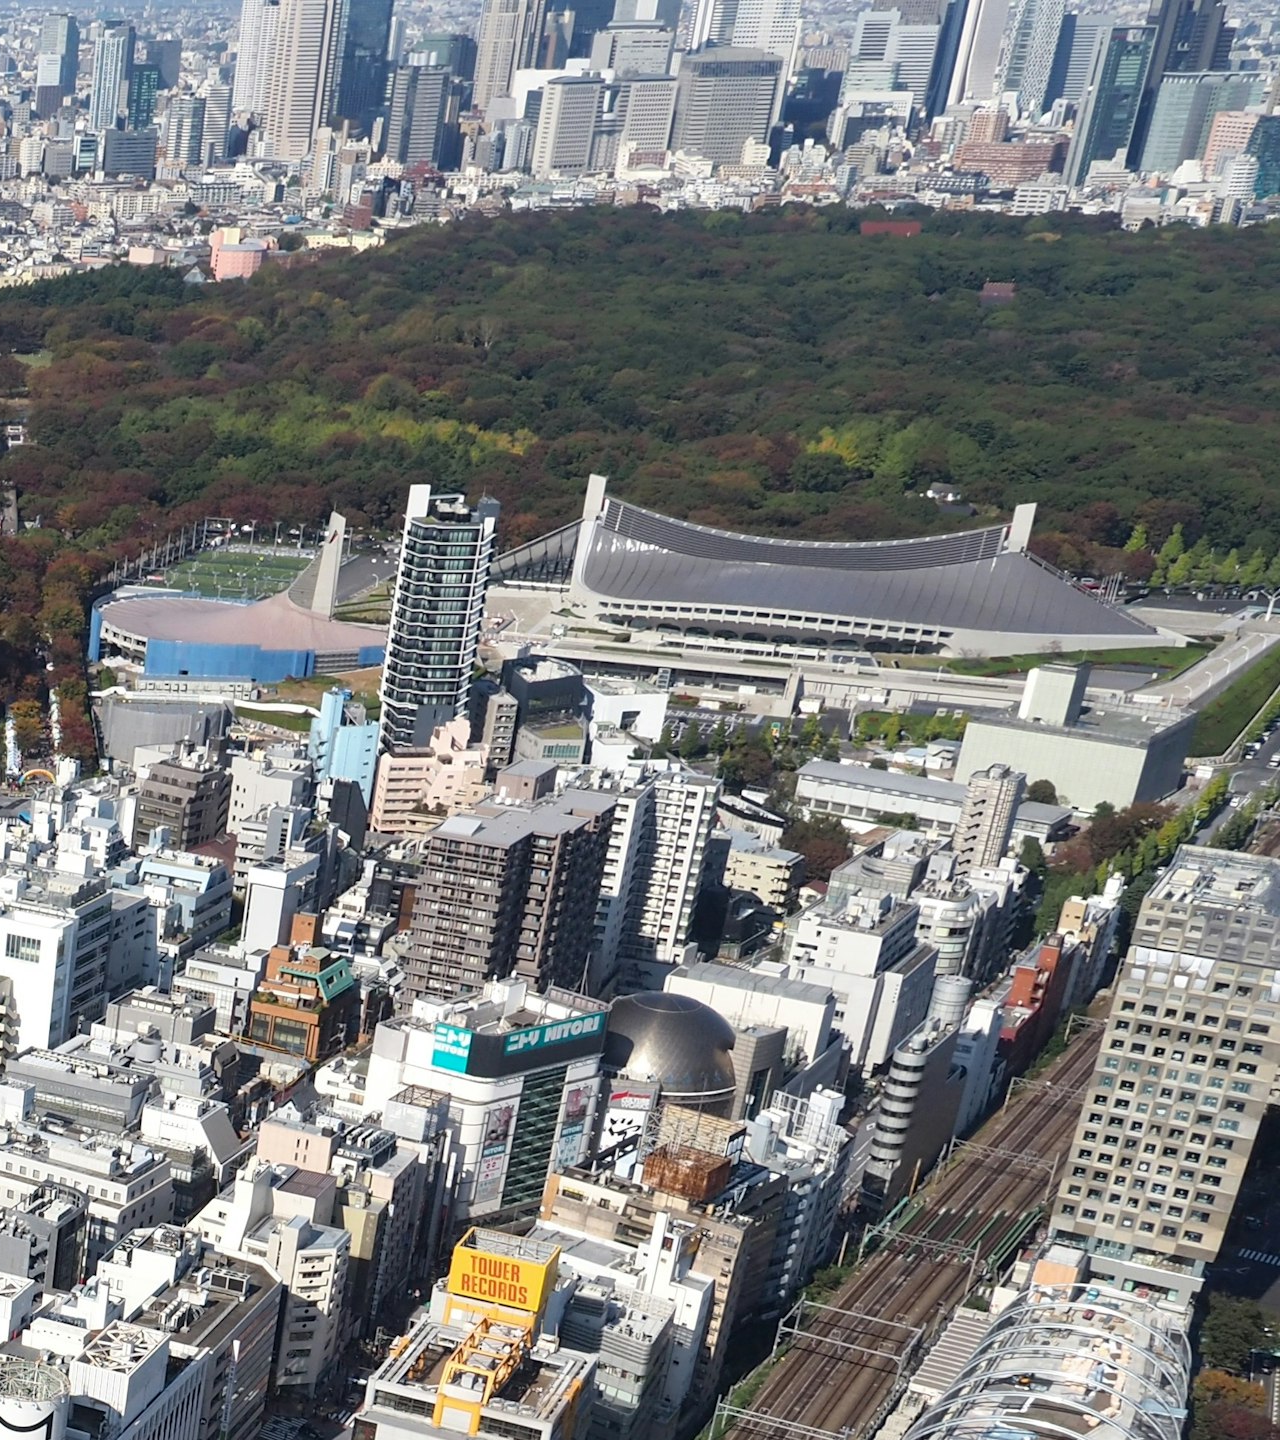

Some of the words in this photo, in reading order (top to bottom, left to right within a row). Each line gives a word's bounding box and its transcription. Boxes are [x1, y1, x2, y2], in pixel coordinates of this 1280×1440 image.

[436, 1027, 472, 1047] ニトリ
[507, 1029, 540, 1052] ニトリ
[544, 1015, 600, 1043] NITORI
[433, 1043, 468, 1058] NITORI
[470, 1255, 521, 1283] TOWER
[461, 1273, 528, 1304] RECORDS
